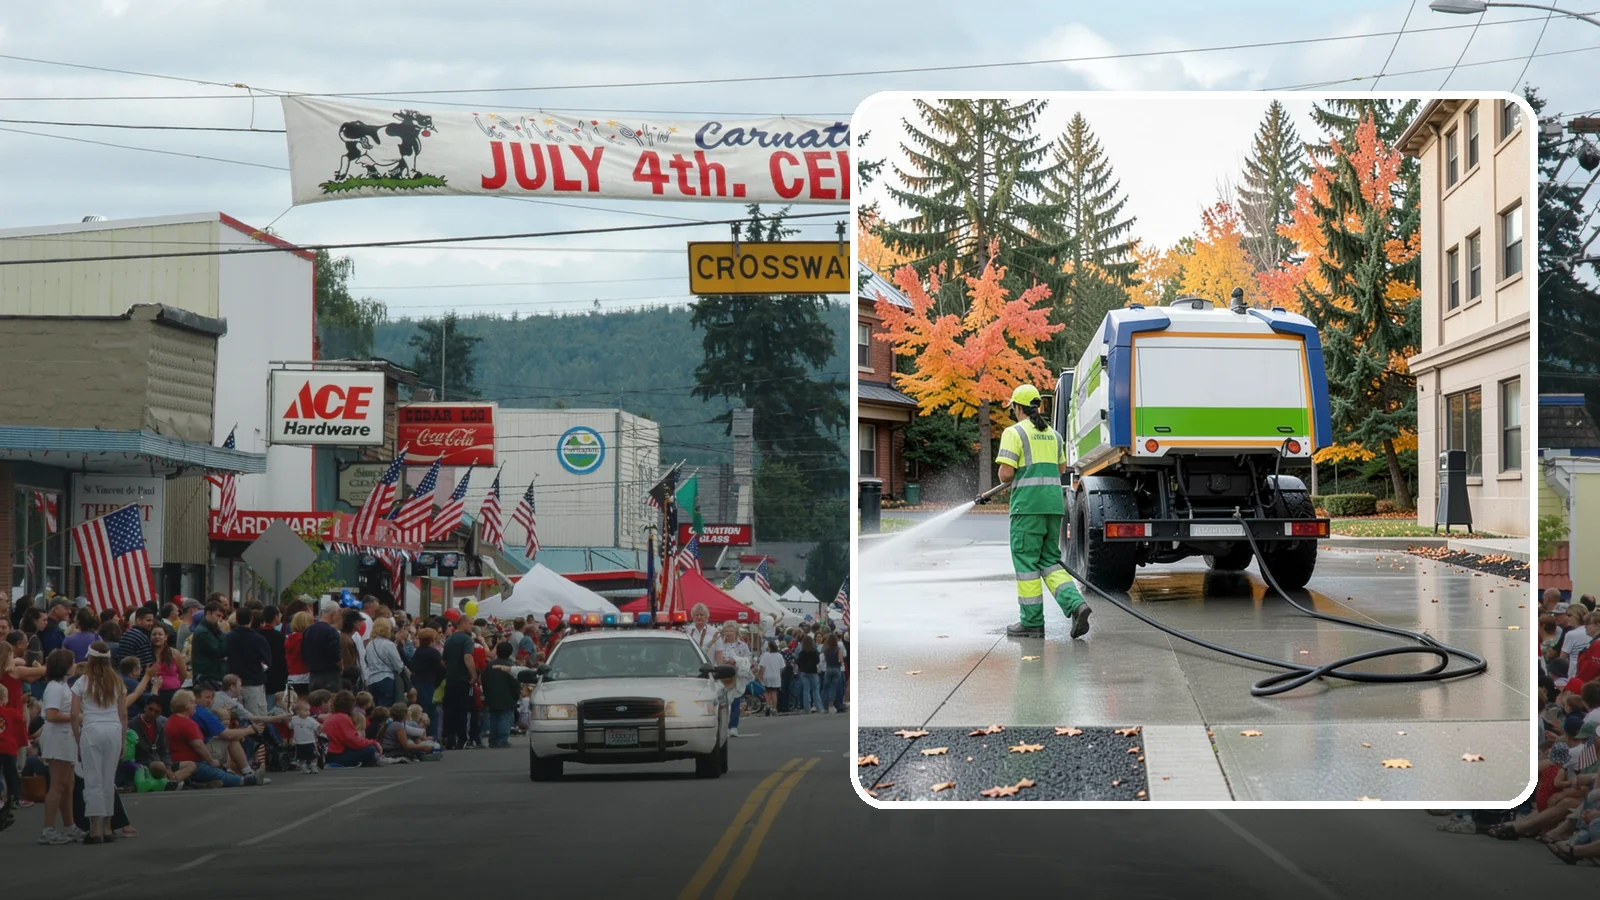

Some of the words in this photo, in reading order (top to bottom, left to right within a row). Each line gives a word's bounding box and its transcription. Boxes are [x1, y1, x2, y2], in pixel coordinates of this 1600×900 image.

[481, 141, 604, 192] JULY
[632, 150, 746, 197] 4th.
[697, 254, 850, 280] CROSSWA
[283, 380, 373, 420] ACE
[406, 409, 452, 422] CEDAR
[462, 409, 484, 422] LOG
[283, 421, 370, 436] Hardware
[417, 428, 477, 447] Coca-Cola
[95, 485, 124, 495] Vincent
[126, 486, 135, 495] de
[137, 486, 155, 495] Paul
[688, 527, 741, 535] CRNATION
[699, 535, 730, 543] GLASS
